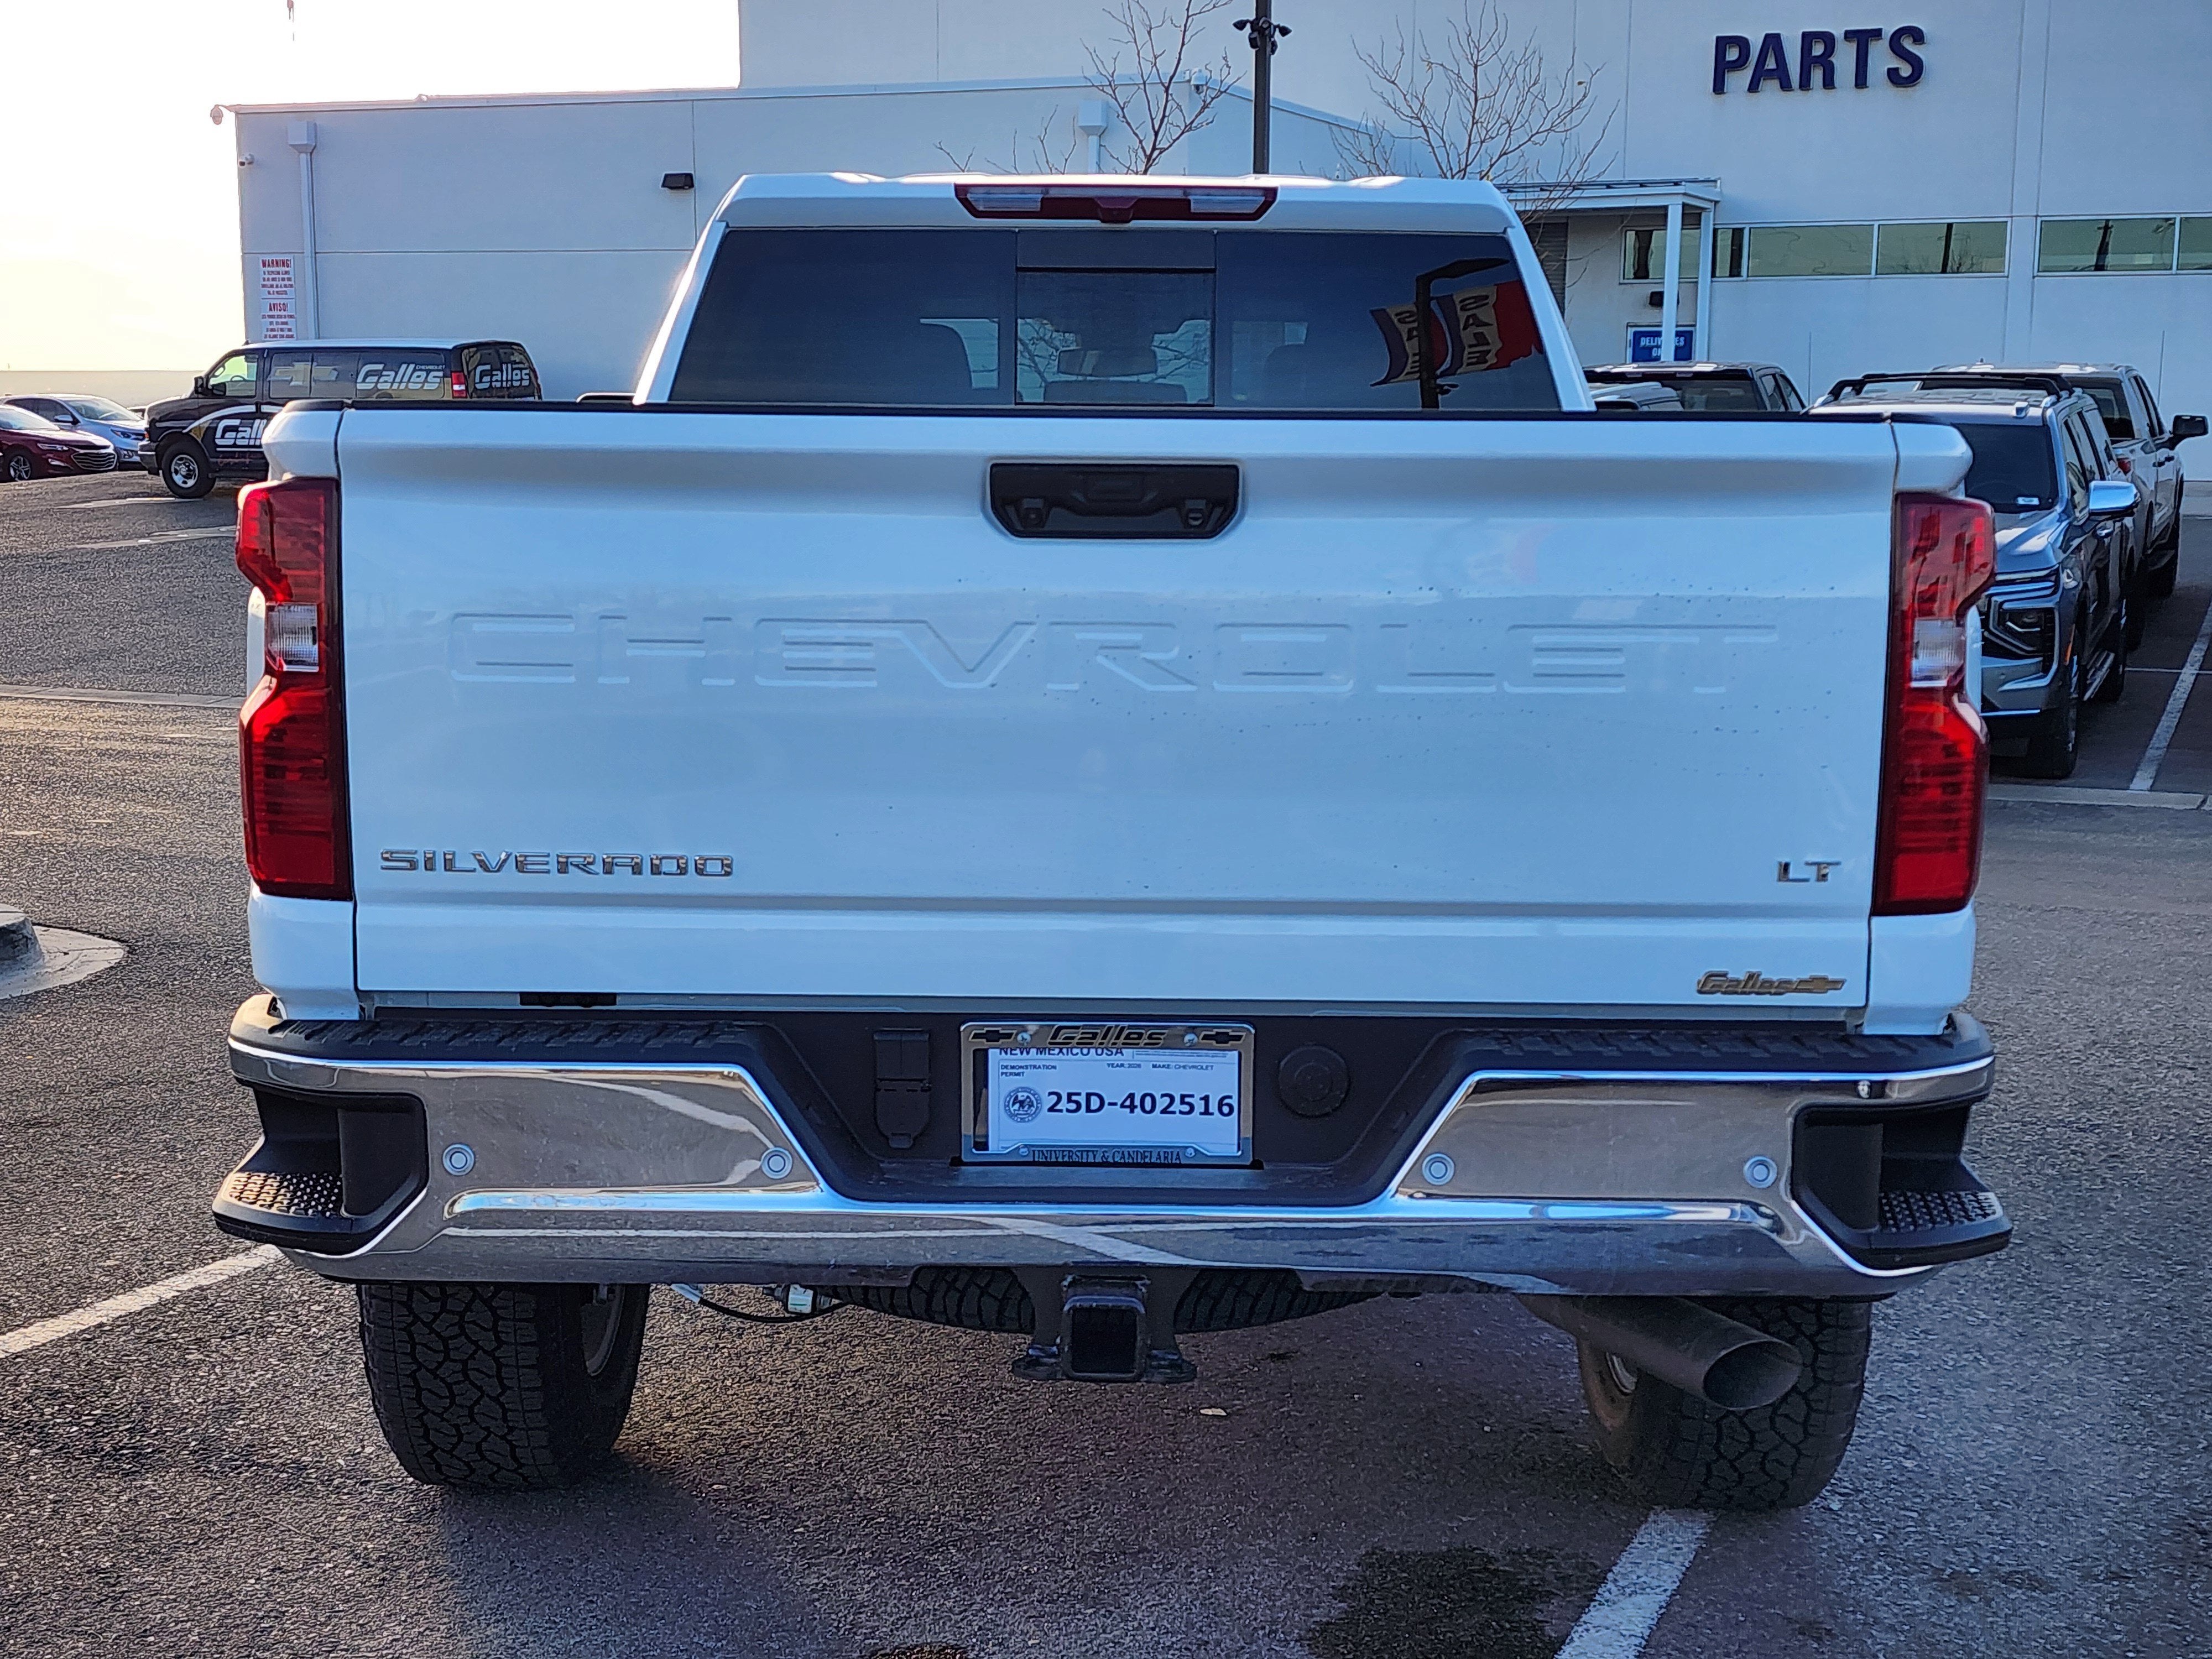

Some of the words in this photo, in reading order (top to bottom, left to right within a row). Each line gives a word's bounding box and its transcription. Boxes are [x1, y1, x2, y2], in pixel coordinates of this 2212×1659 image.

[1713, 25, 1927, 95] PARTS
[261, 258, 292, 268] WARNING!
[269, 302, 289, 312] AVISO!
[1640, 336, 1685, 347] DELIVES
[356, 363, 444, 390] Galles
[474, 363, 530, 389] Galles
[215, 419, 267, 445] Gall
[450, 613, 1778, 696] CHEVROLET
[380, 849, 734, 878] SILVERADO
[1776, 860, 1841, 882] LT
[1047, 1024, 1168, 1047] Galles
[999, 1047, 1032, 1056] NEW
[1035, 1047, 1090, 1057] MEXICO
[1095, 1048, 1125, 1057] USA
[1046, 1091, 1235, 1118] 25D-402516
[1032, 1149, 1099, 1162] UNIVERSITY
[1100, 1150, 1110, 1162] &
[1113, 1150, 1182, 1165] CANDELARIA
